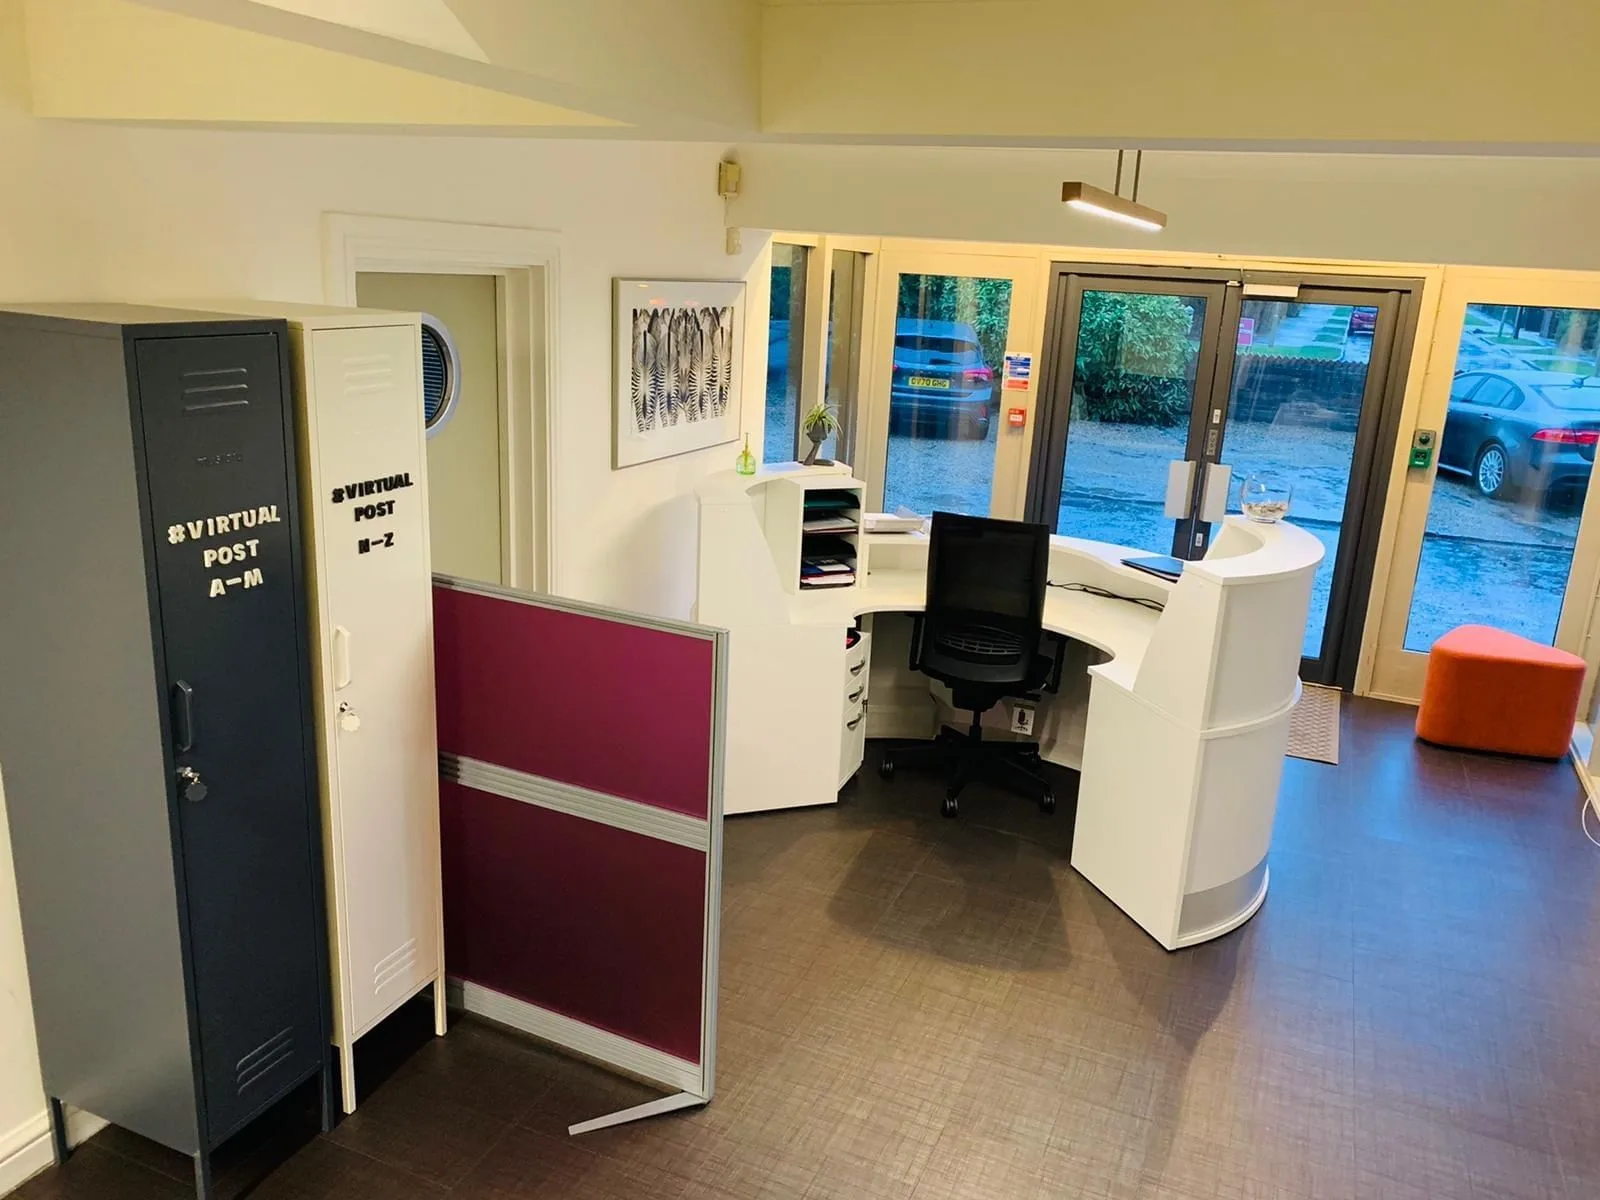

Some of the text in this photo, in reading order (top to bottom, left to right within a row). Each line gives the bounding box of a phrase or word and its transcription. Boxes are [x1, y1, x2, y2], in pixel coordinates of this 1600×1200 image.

[332, 472, 414, 504] #VIRTUAL
[167, 504, 281, 545] #VIRTUAL
[354, 500, 396, 522] POST
[203, 538, 260, 569] POST
[209, 567, 265, 599] A-M
